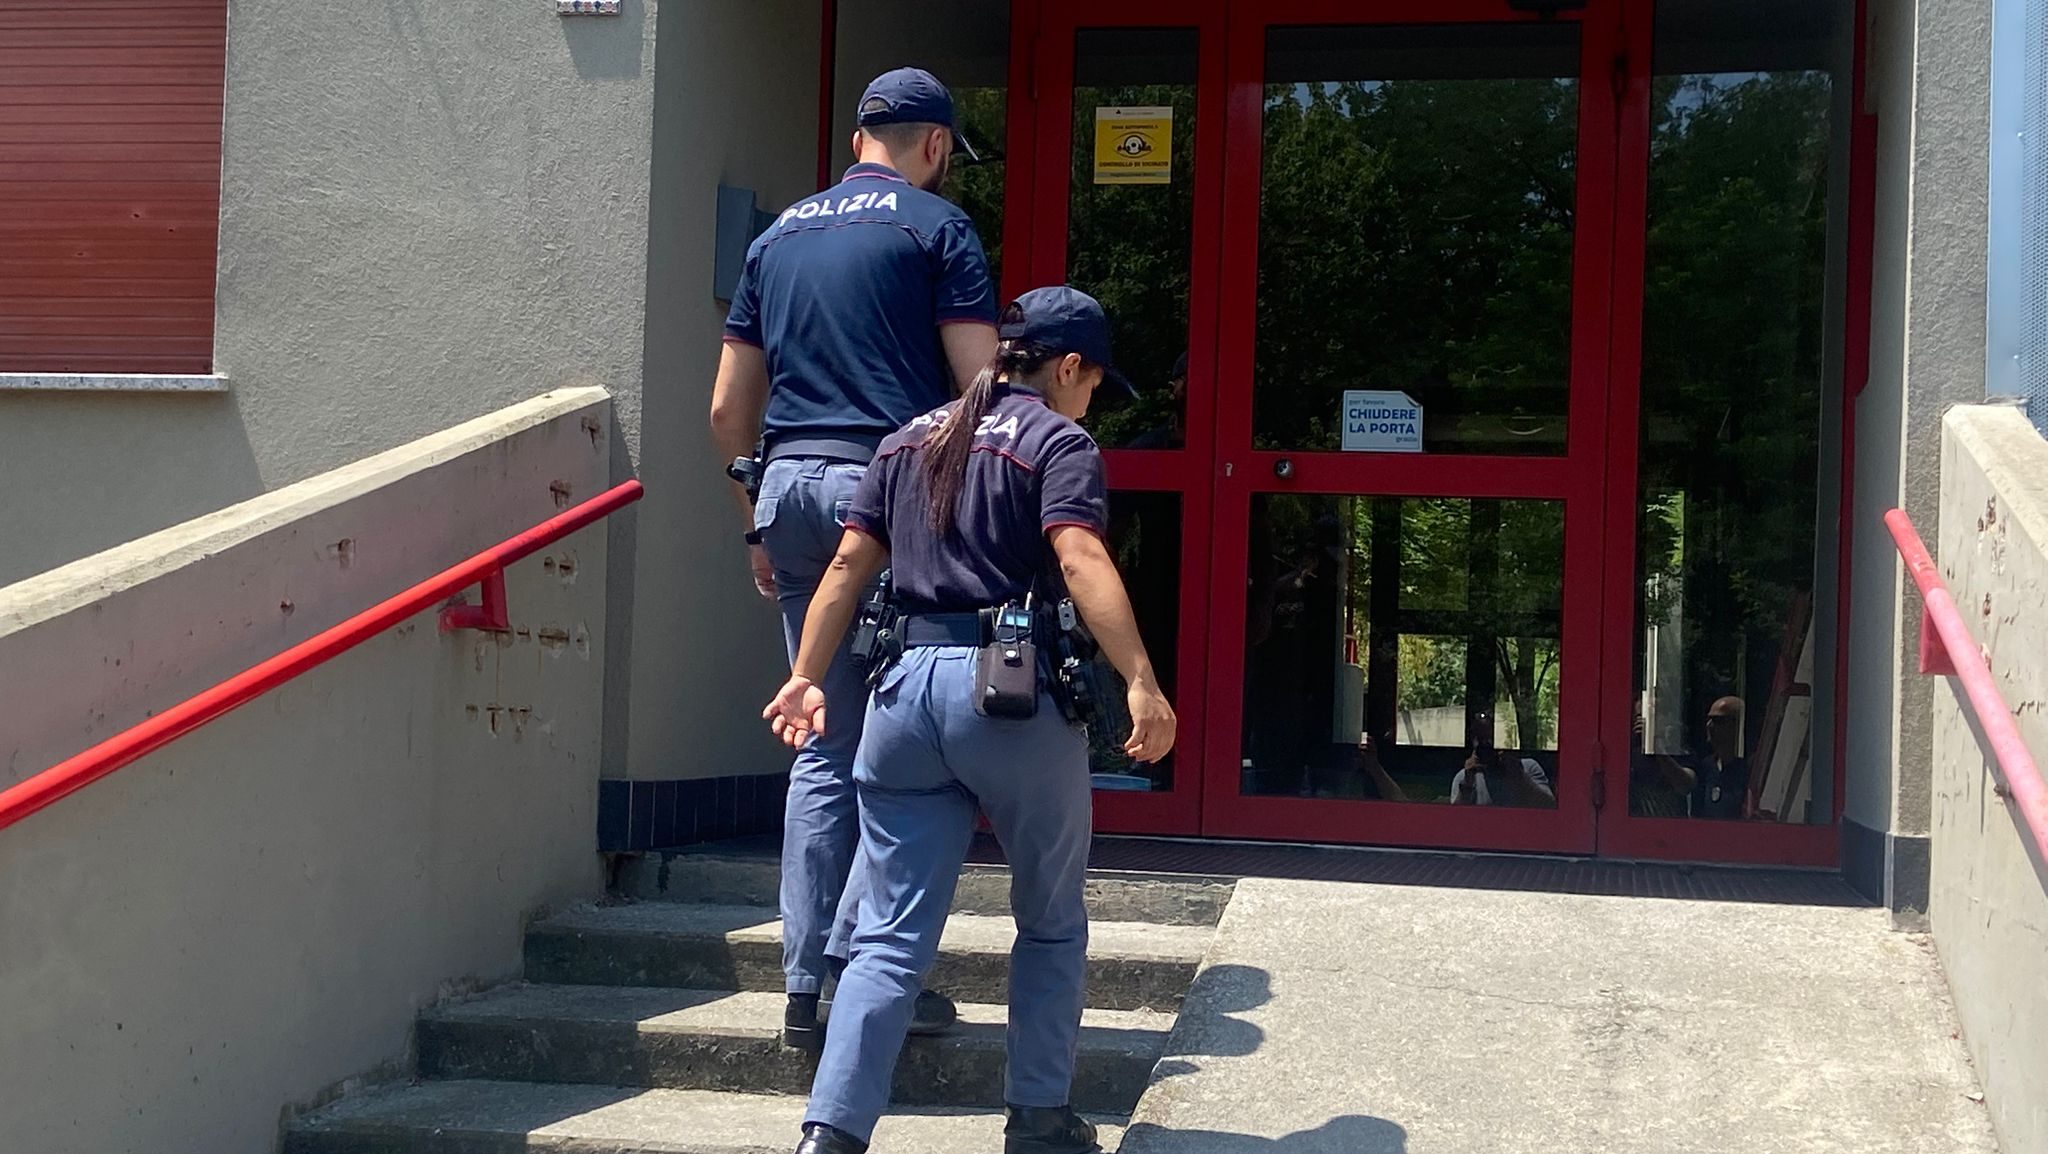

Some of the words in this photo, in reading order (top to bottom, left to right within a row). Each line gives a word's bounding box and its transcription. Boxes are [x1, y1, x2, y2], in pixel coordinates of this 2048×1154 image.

[779, 191, 898, 228] POLIZIA
[1348, 408, 1417, 420] CHIUDERE
[906, 410, 1018, 440] POZIA
[1349, 422, 1366, 433] LA
[1369, 423, 1416, 434] PORTA
